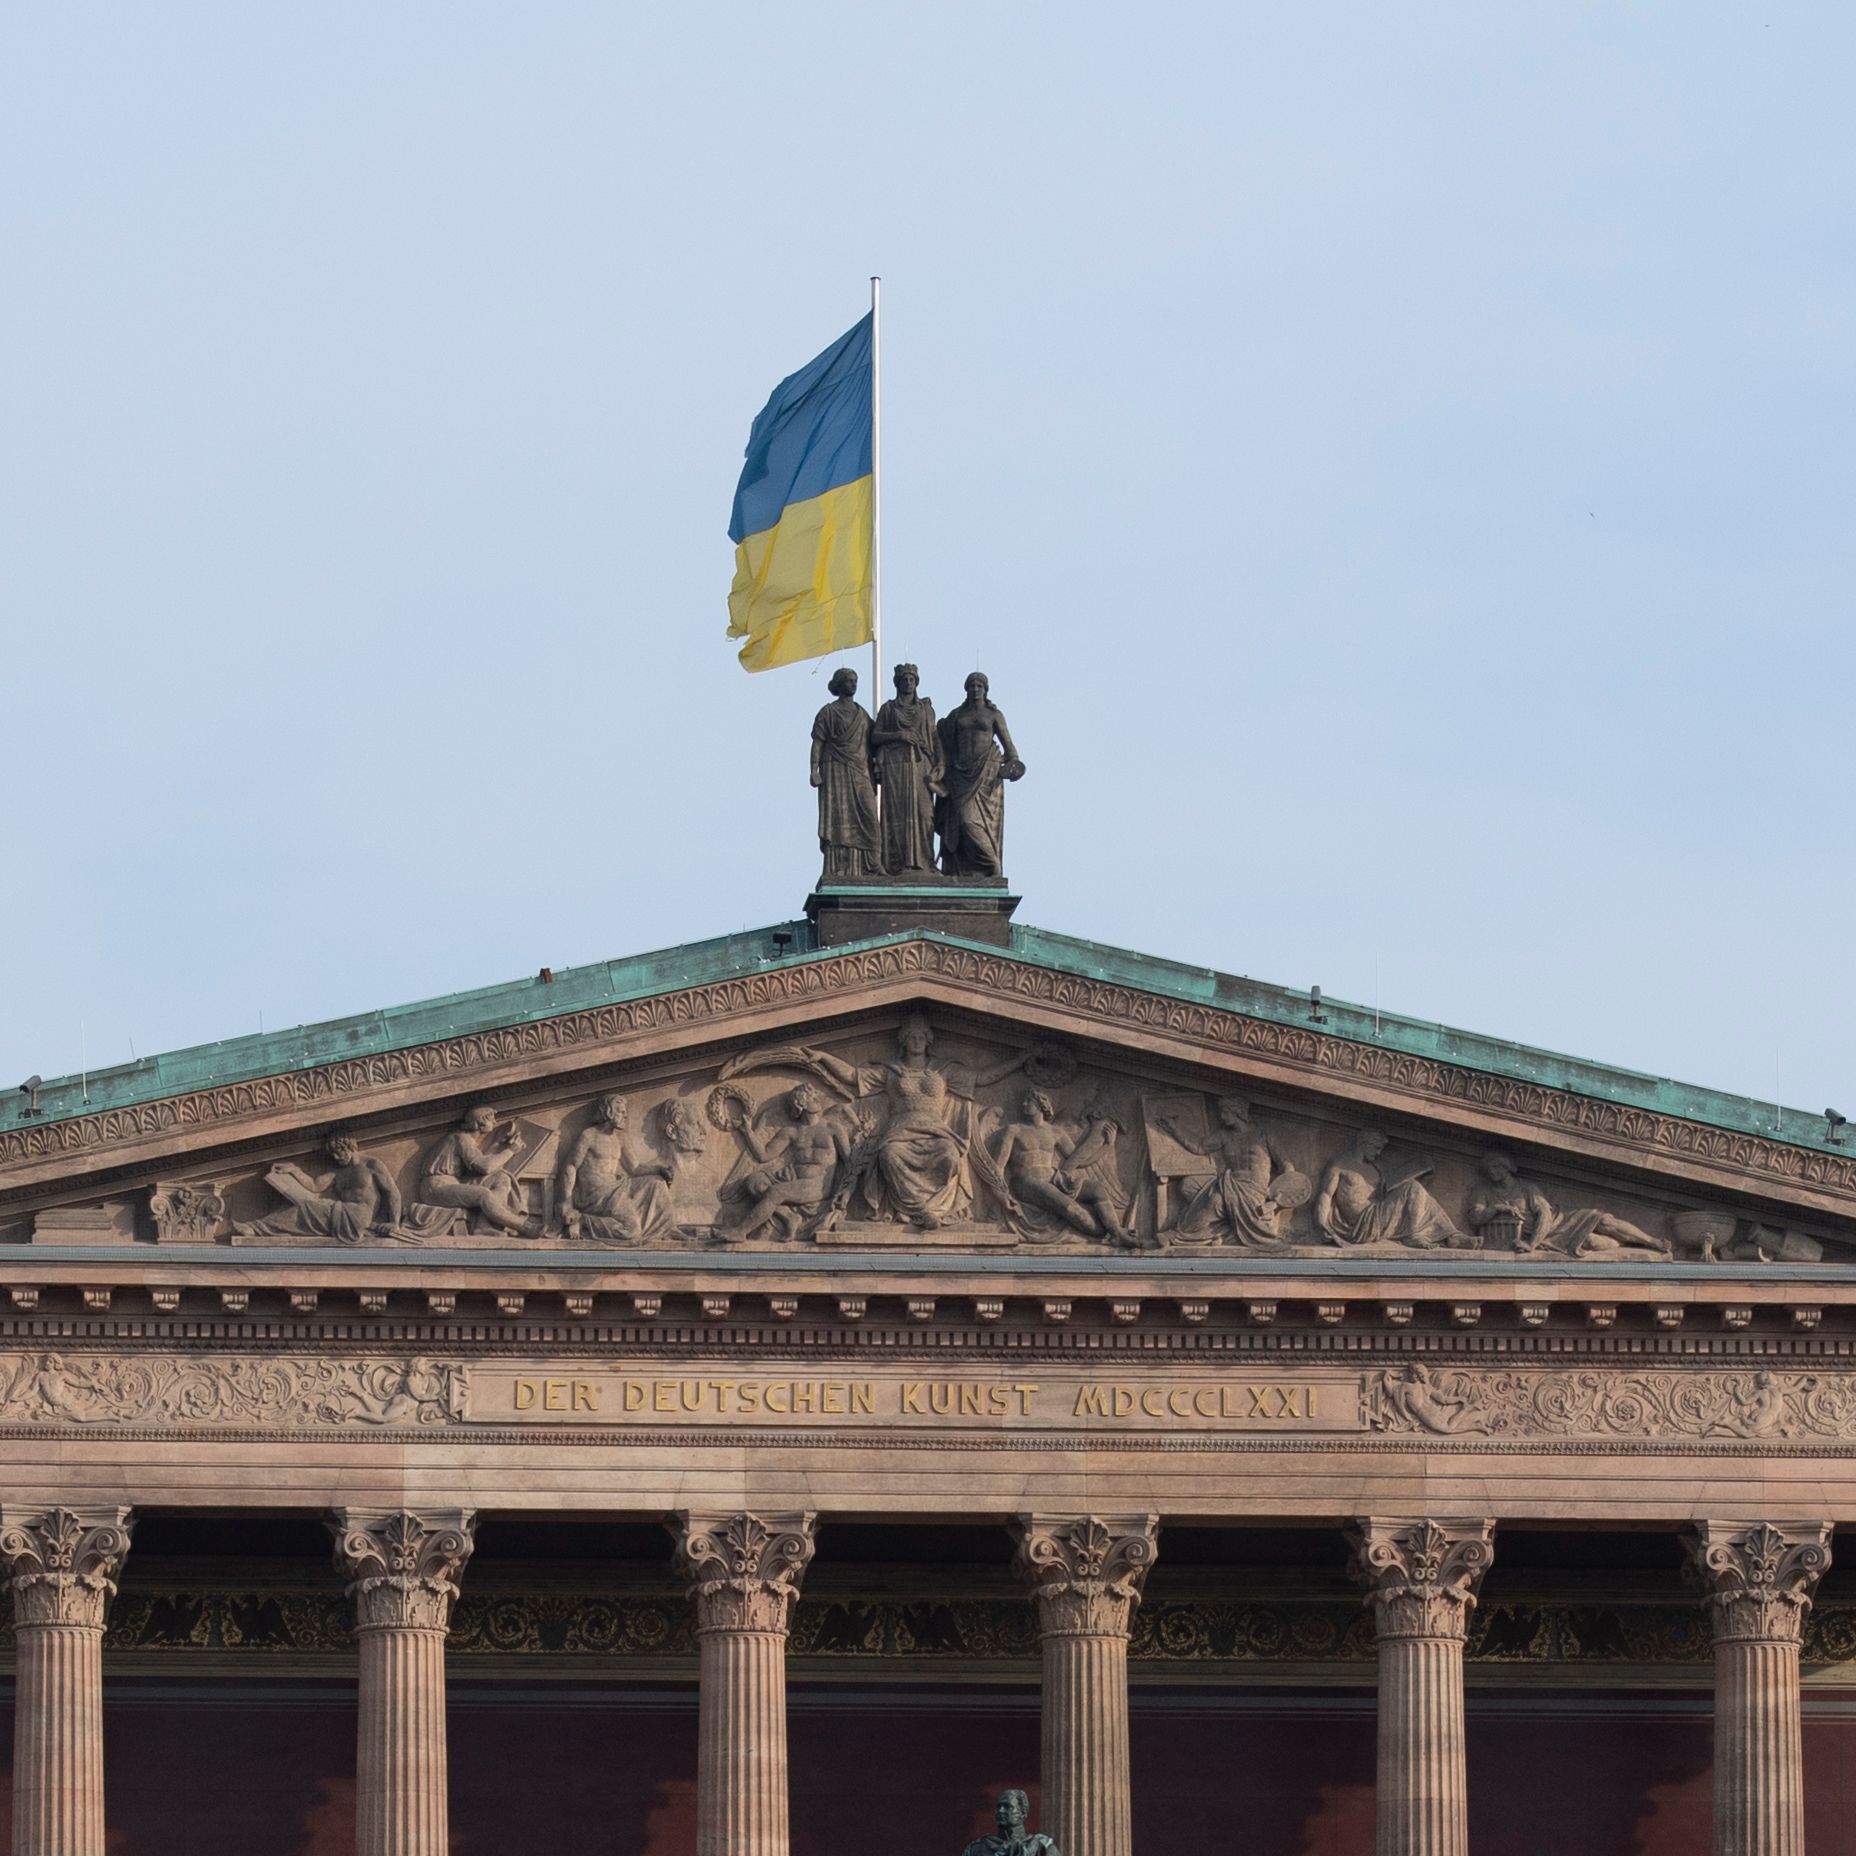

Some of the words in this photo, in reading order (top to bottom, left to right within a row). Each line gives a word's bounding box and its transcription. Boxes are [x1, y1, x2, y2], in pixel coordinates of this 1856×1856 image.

[514, 1378, 599, 1411] DER
[624, 1379, 877, 1414] DEUTSCHEN
[900, 1382, 1040, 1416] KUNST
[1074, 1384, 1318, 1418] MDCCCLXXI
